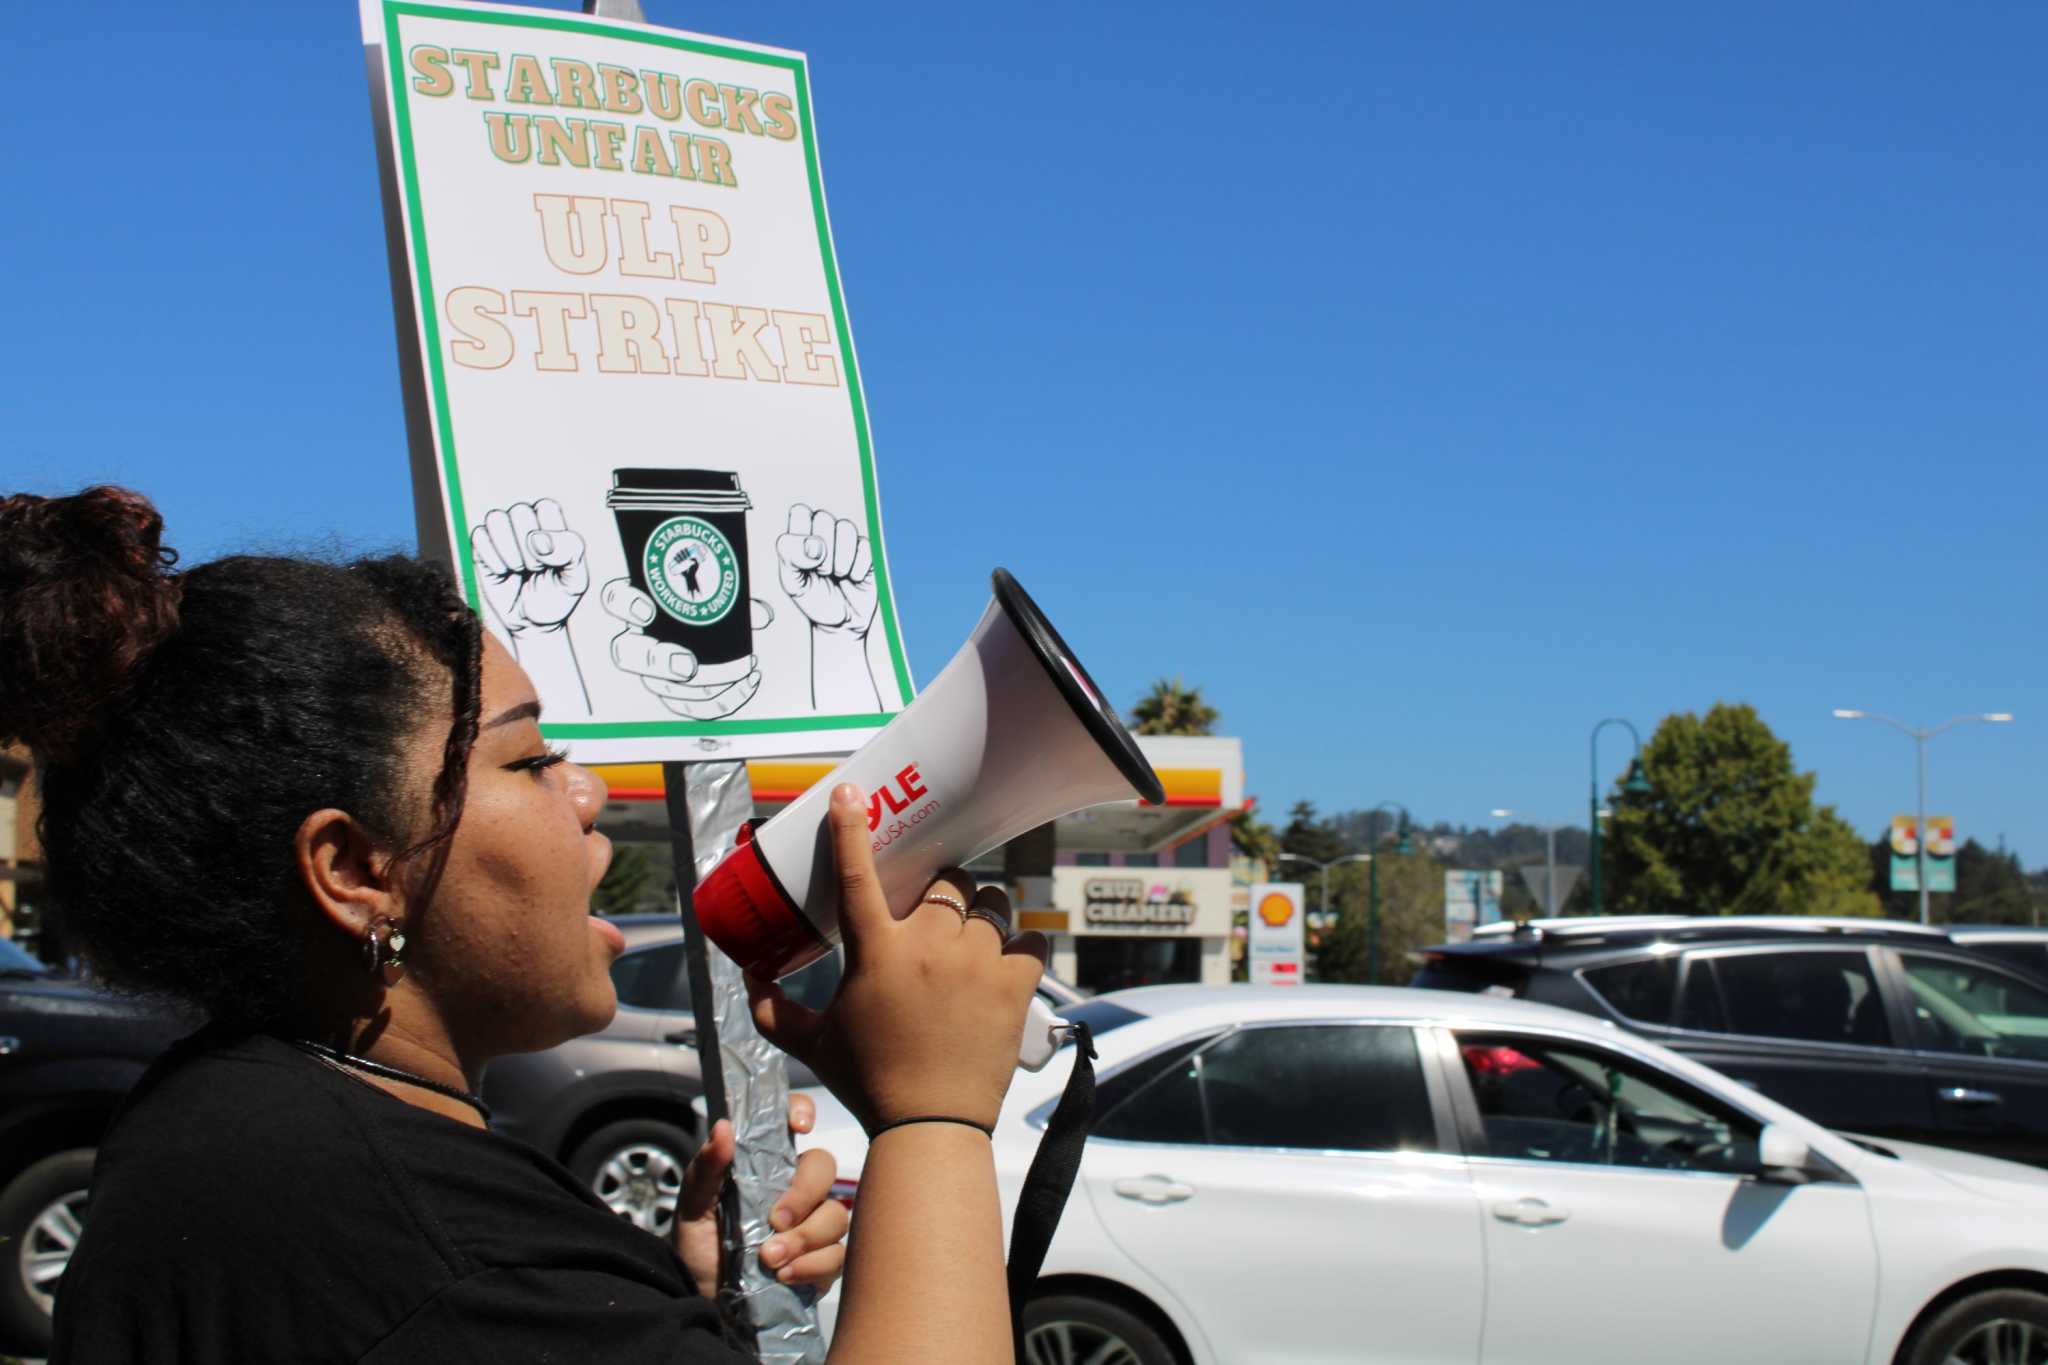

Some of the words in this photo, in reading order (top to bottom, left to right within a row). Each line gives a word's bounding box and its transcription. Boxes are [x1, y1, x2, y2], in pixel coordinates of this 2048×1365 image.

[409, 44, 797, 142] STARBUCKS
[483, 111, 739, 188] UNFAIR
[533, 193, 730, 284] ULP
[445, 285, 840, 387] STRIKE
[654, 523, 725, 555] STARBUCKS
[649, 567, 698, 617] WORKERS
[707, 570, 735, 613] UNITED
[866, 763, 929, 833] YLE
[872, 799, 941, 853] eUSA.com
